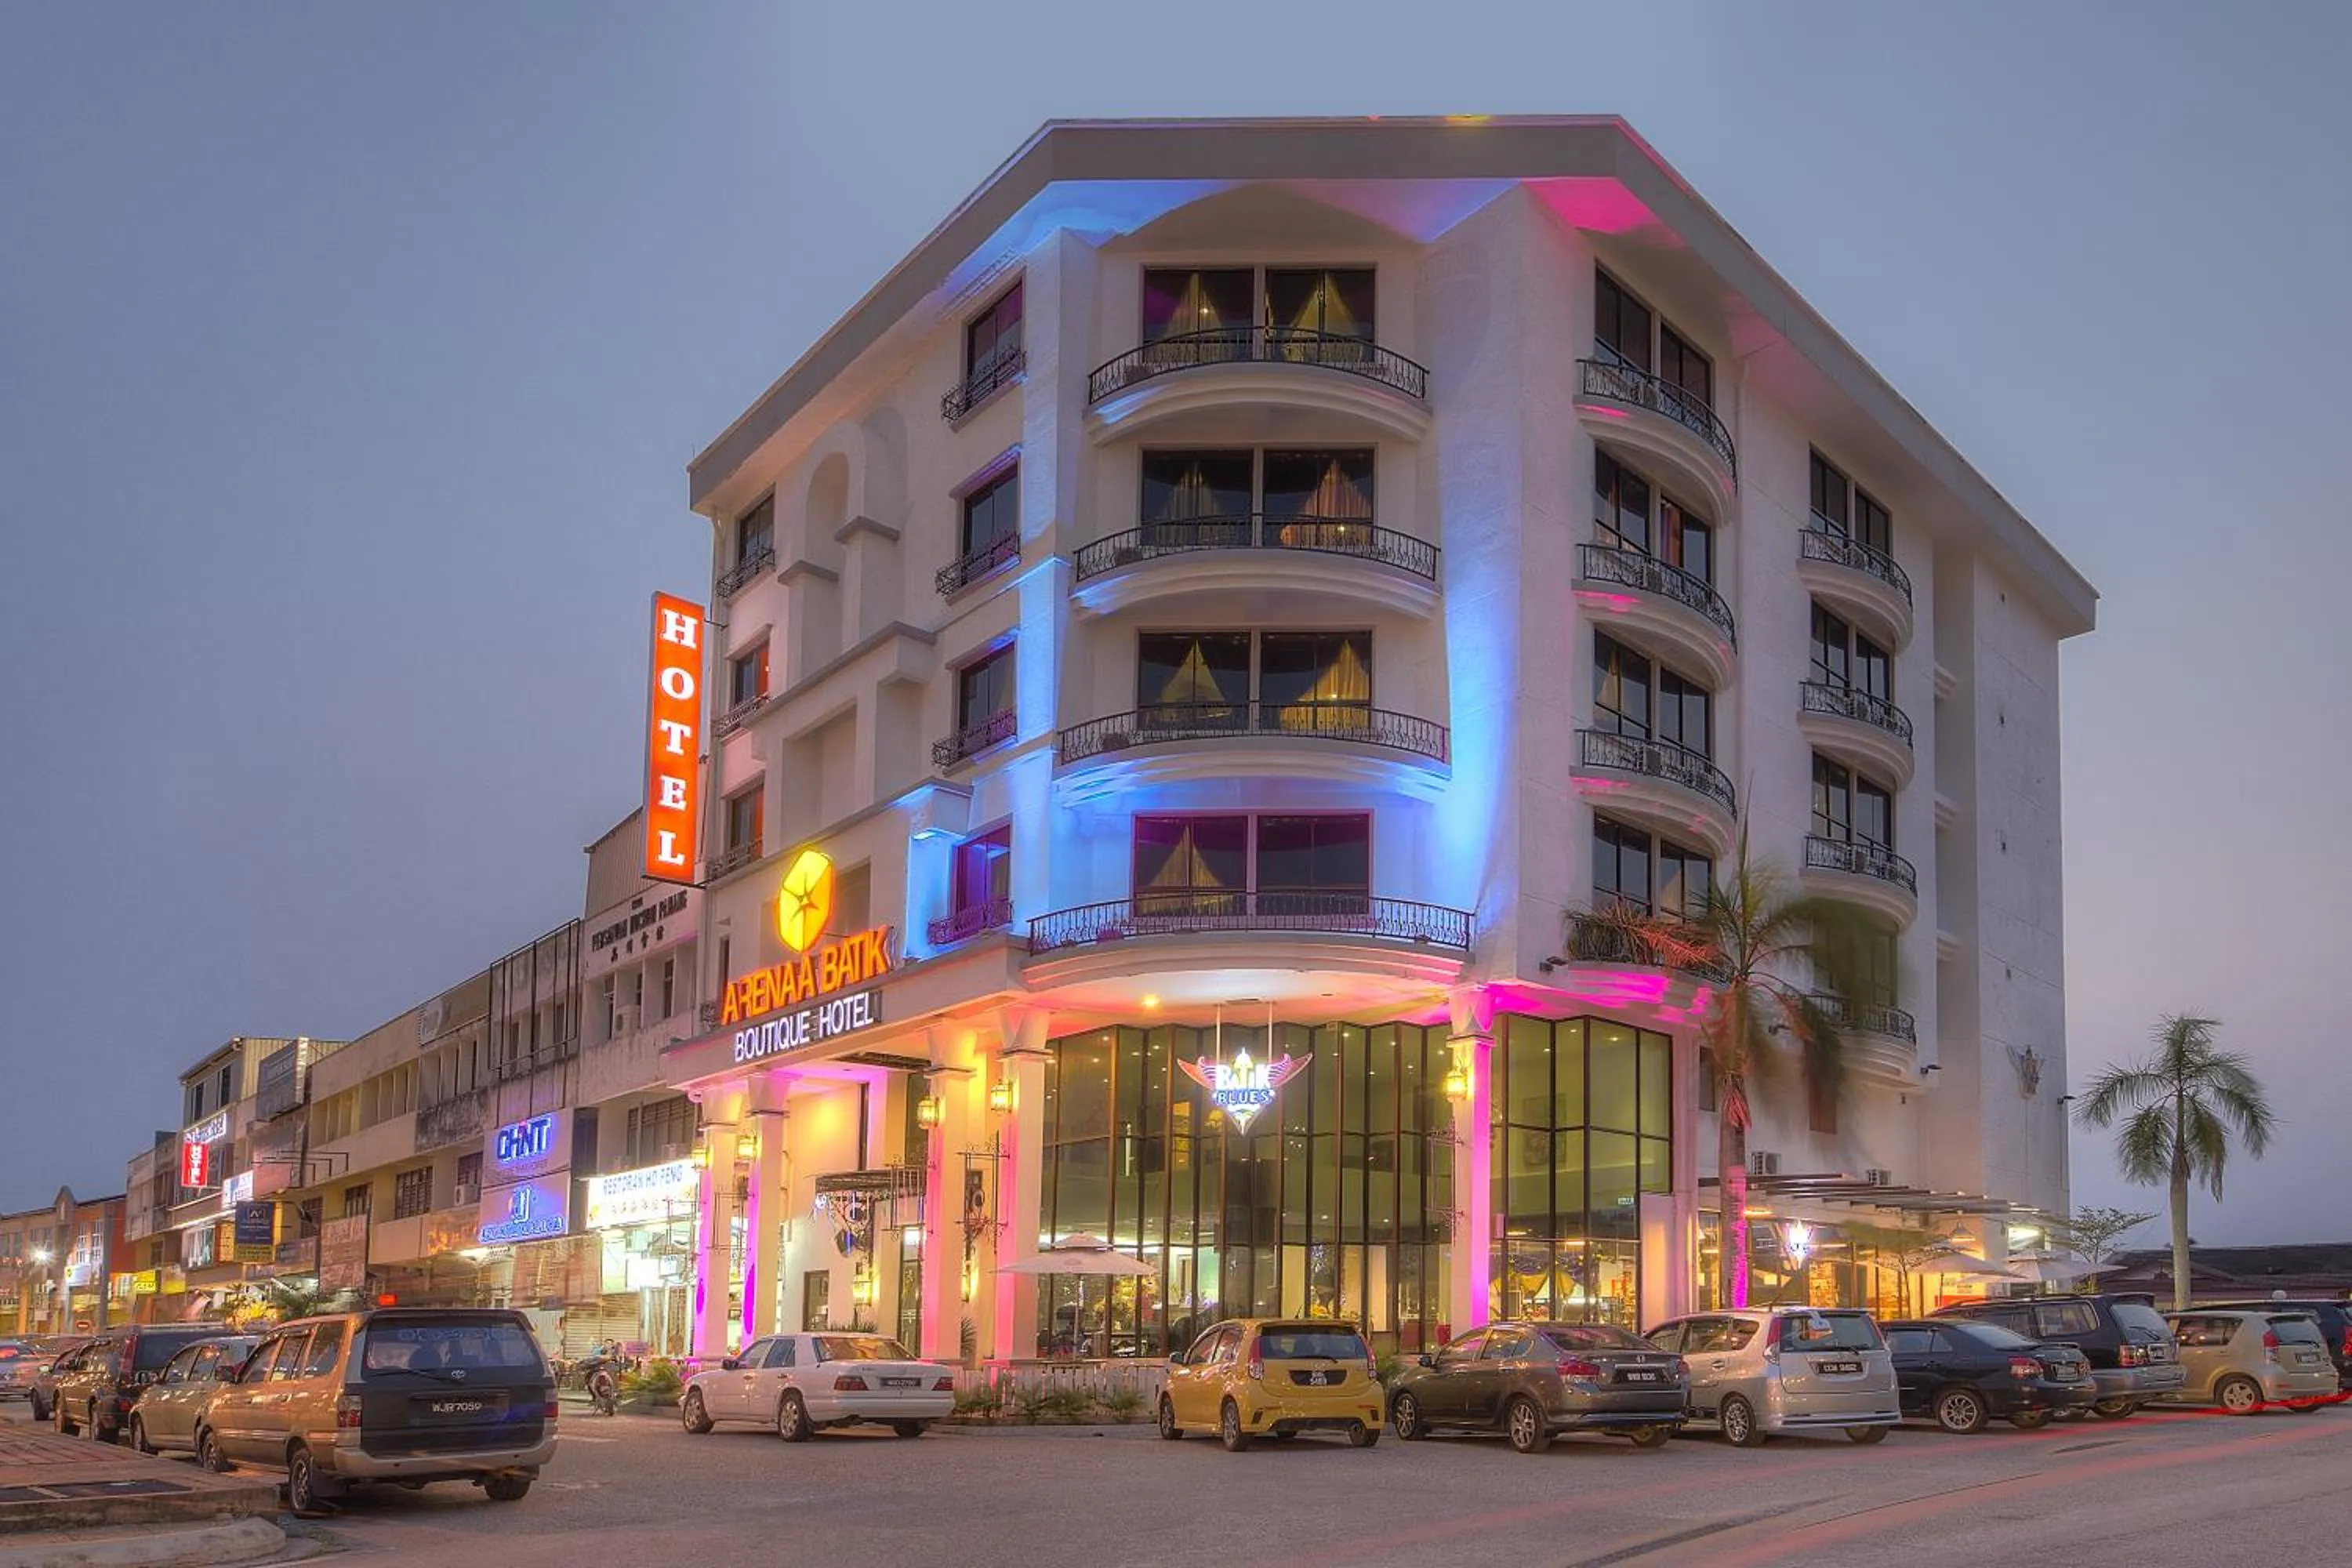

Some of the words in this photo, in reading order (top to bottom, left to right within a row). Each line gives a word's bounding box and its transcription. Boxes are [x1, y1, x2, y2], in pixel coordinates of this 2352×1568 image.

[657, 608, 699, 867] HOTEL
[820, 924, 889, 993] BATIK
[734, 1010, 811, 1063] BOUTIQUE
[819, 991, 874, 1039] HOTEL
[1217, 1089, 1270, 1105] BLUES
